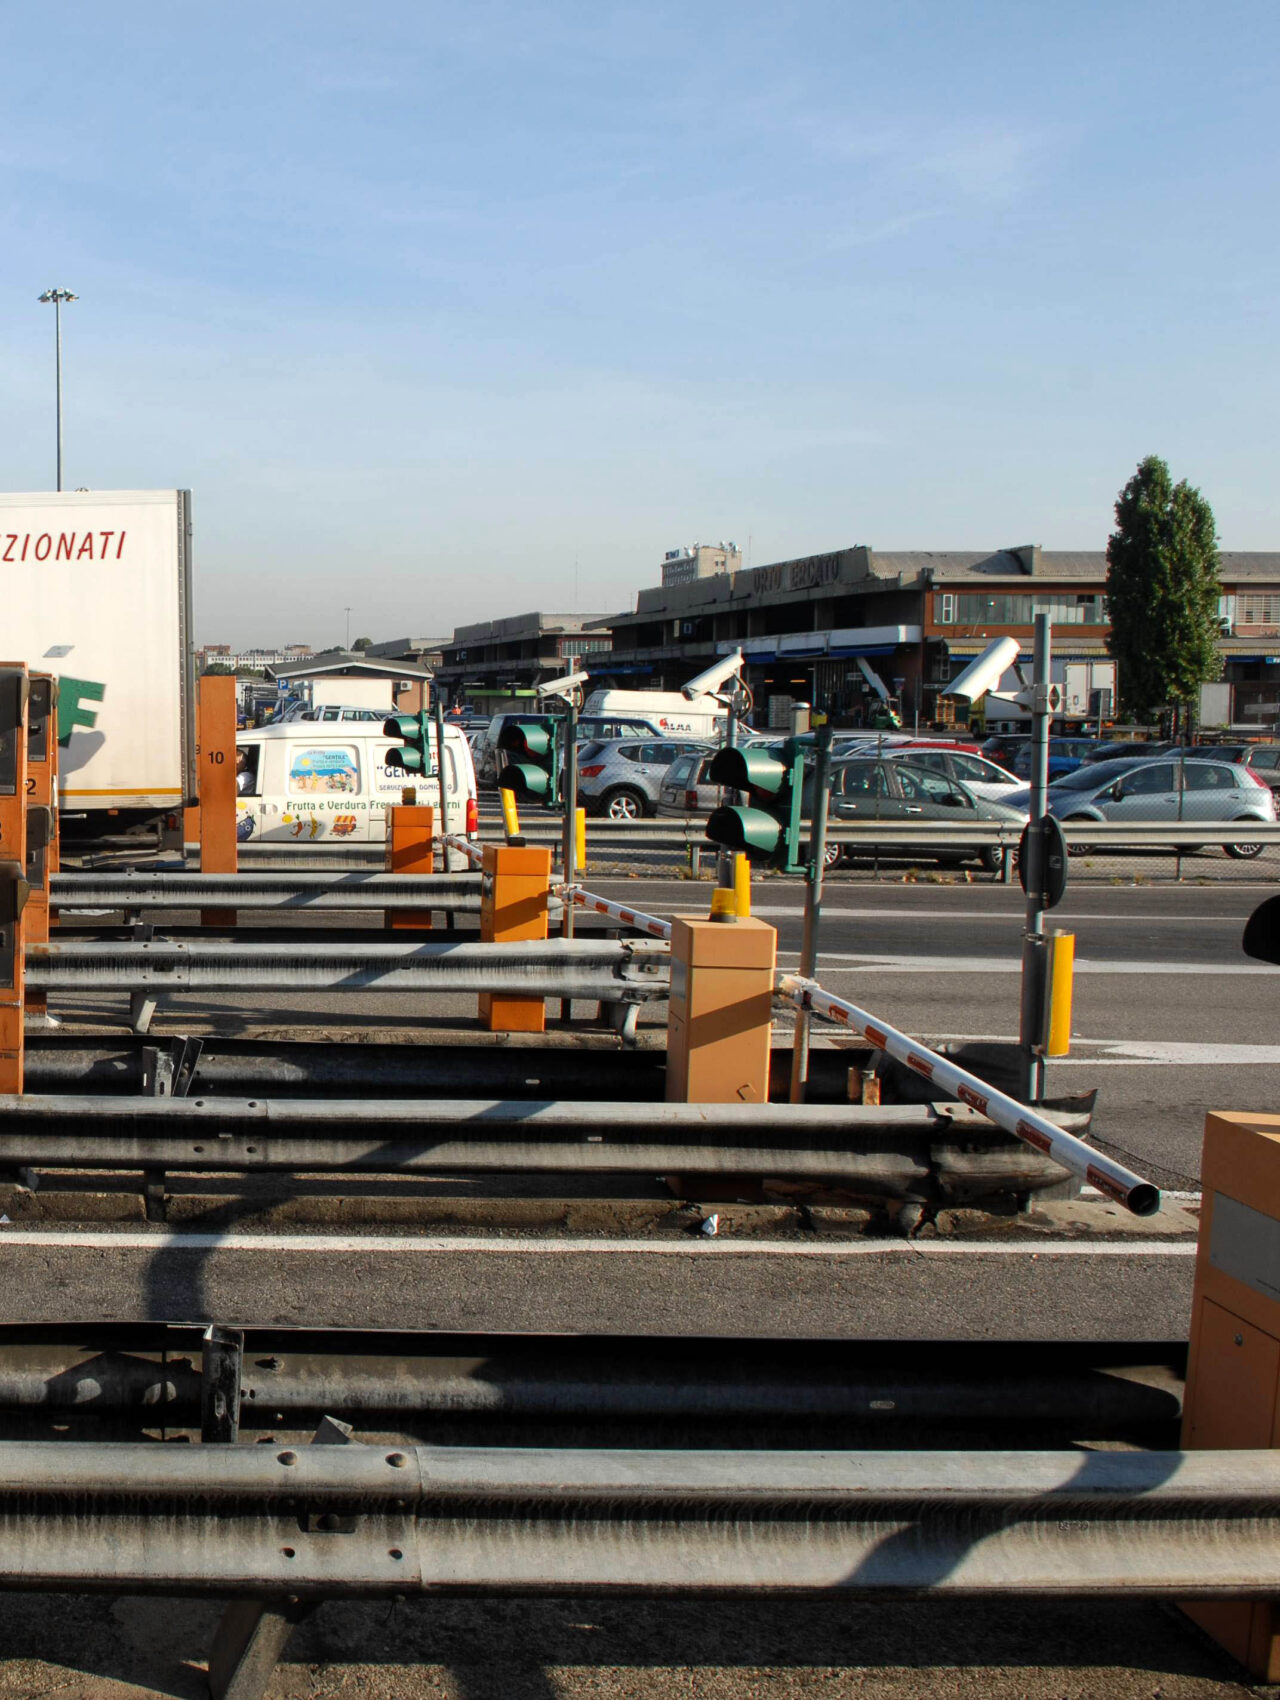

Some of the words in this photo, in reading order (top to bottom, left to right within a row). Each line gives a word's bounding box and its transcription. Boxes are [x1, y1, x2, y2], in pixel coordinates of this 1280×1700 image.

[208, 751, 225, 764] 10
[286, 801, 316, 810] Frutta
[327, 801, 367, 810] Verdura
